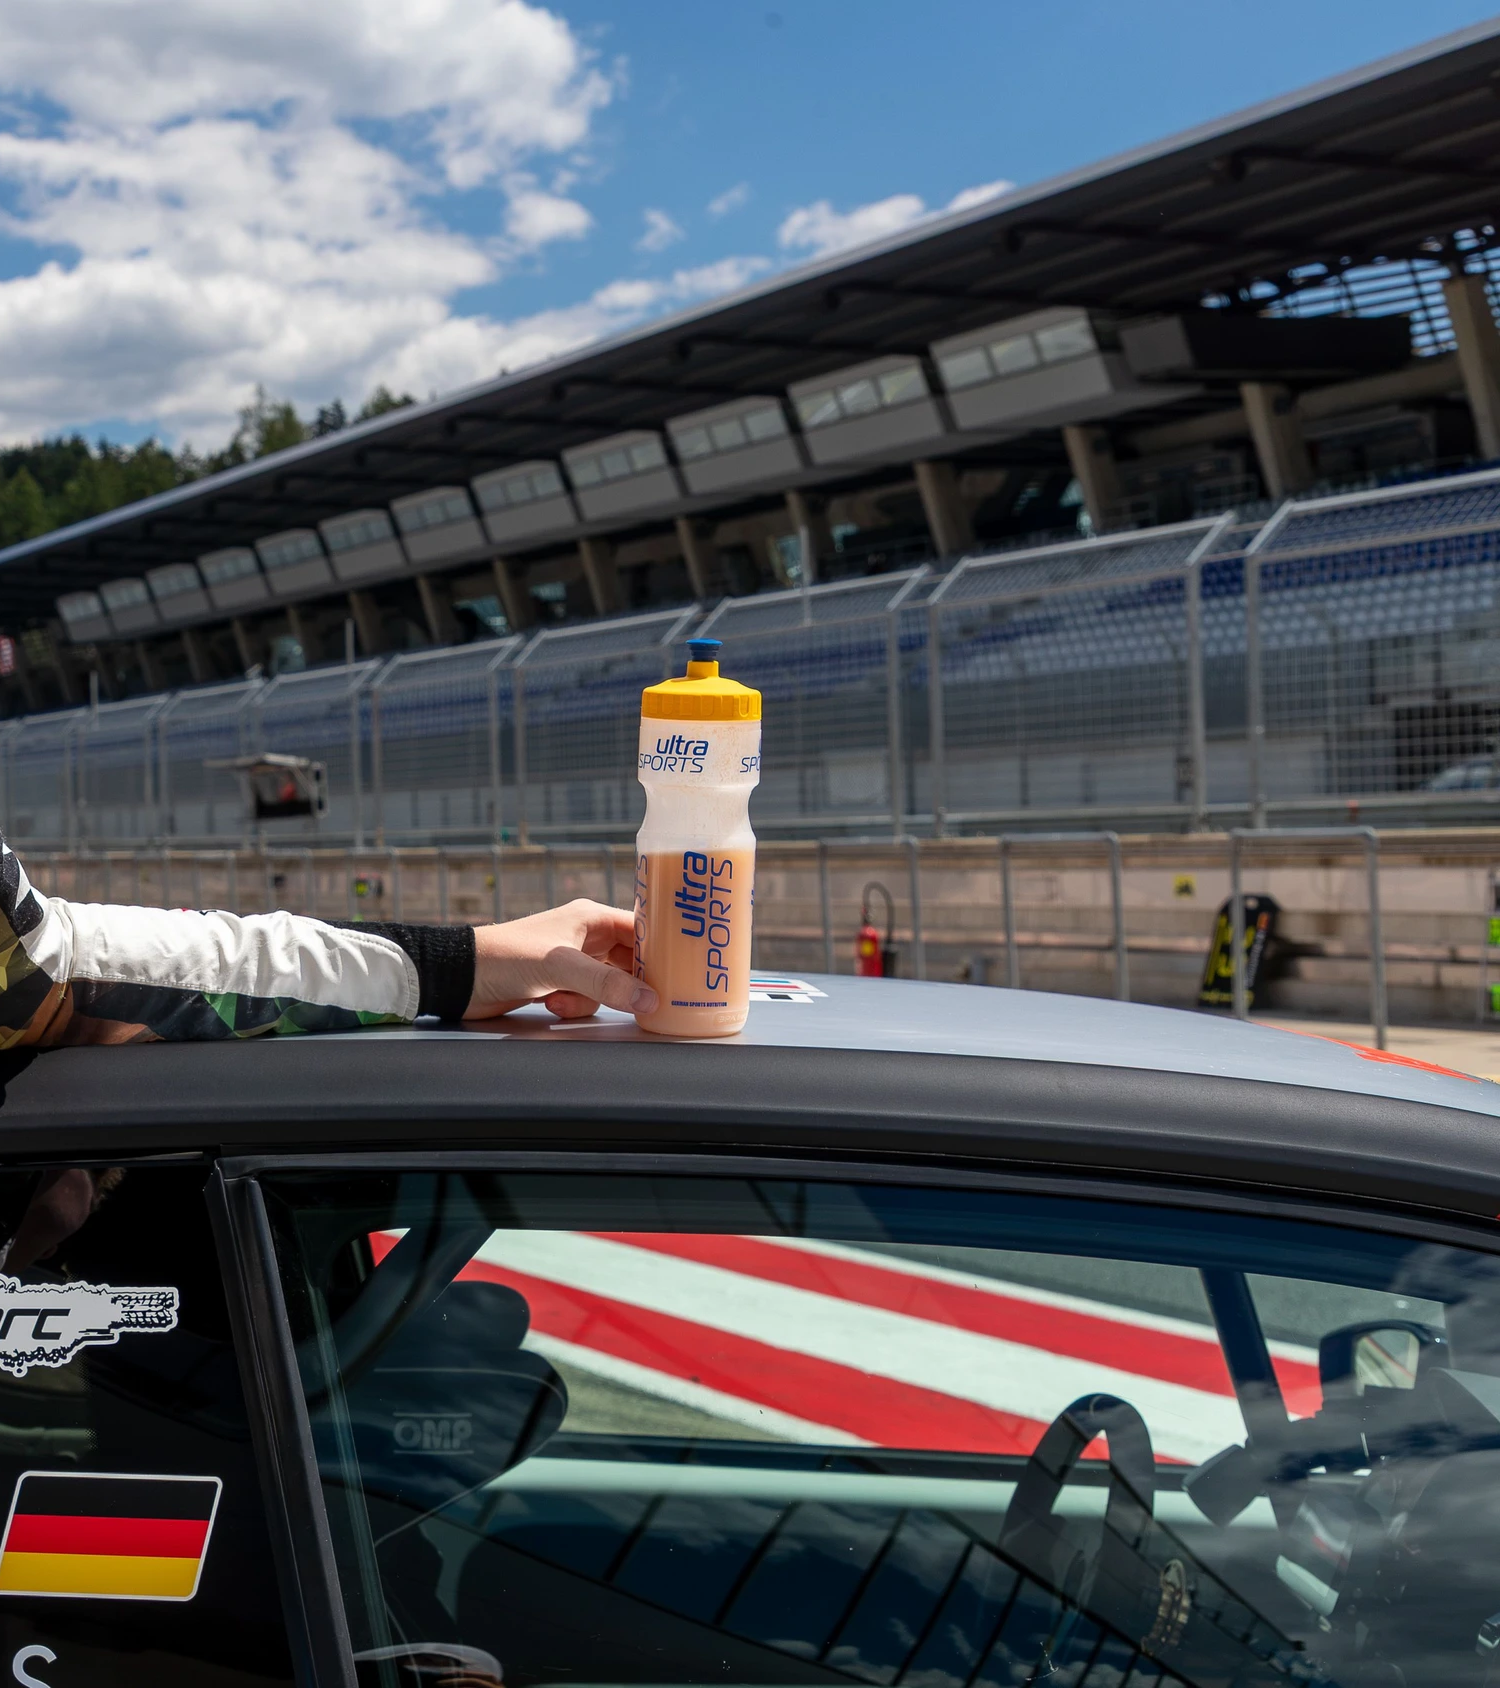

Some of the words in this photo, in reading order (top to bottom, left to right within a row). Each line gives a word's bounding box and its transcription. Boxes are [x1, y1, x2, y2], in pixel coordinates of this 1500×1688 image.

[656, 735, 709, 756] ultra
[639, 753, 705, 773] SPORTS
[674, 851, 707, 937] ultra
[706, 857, 733, 993] SPORTS
[393, 1418, 473, 1449] OMP
